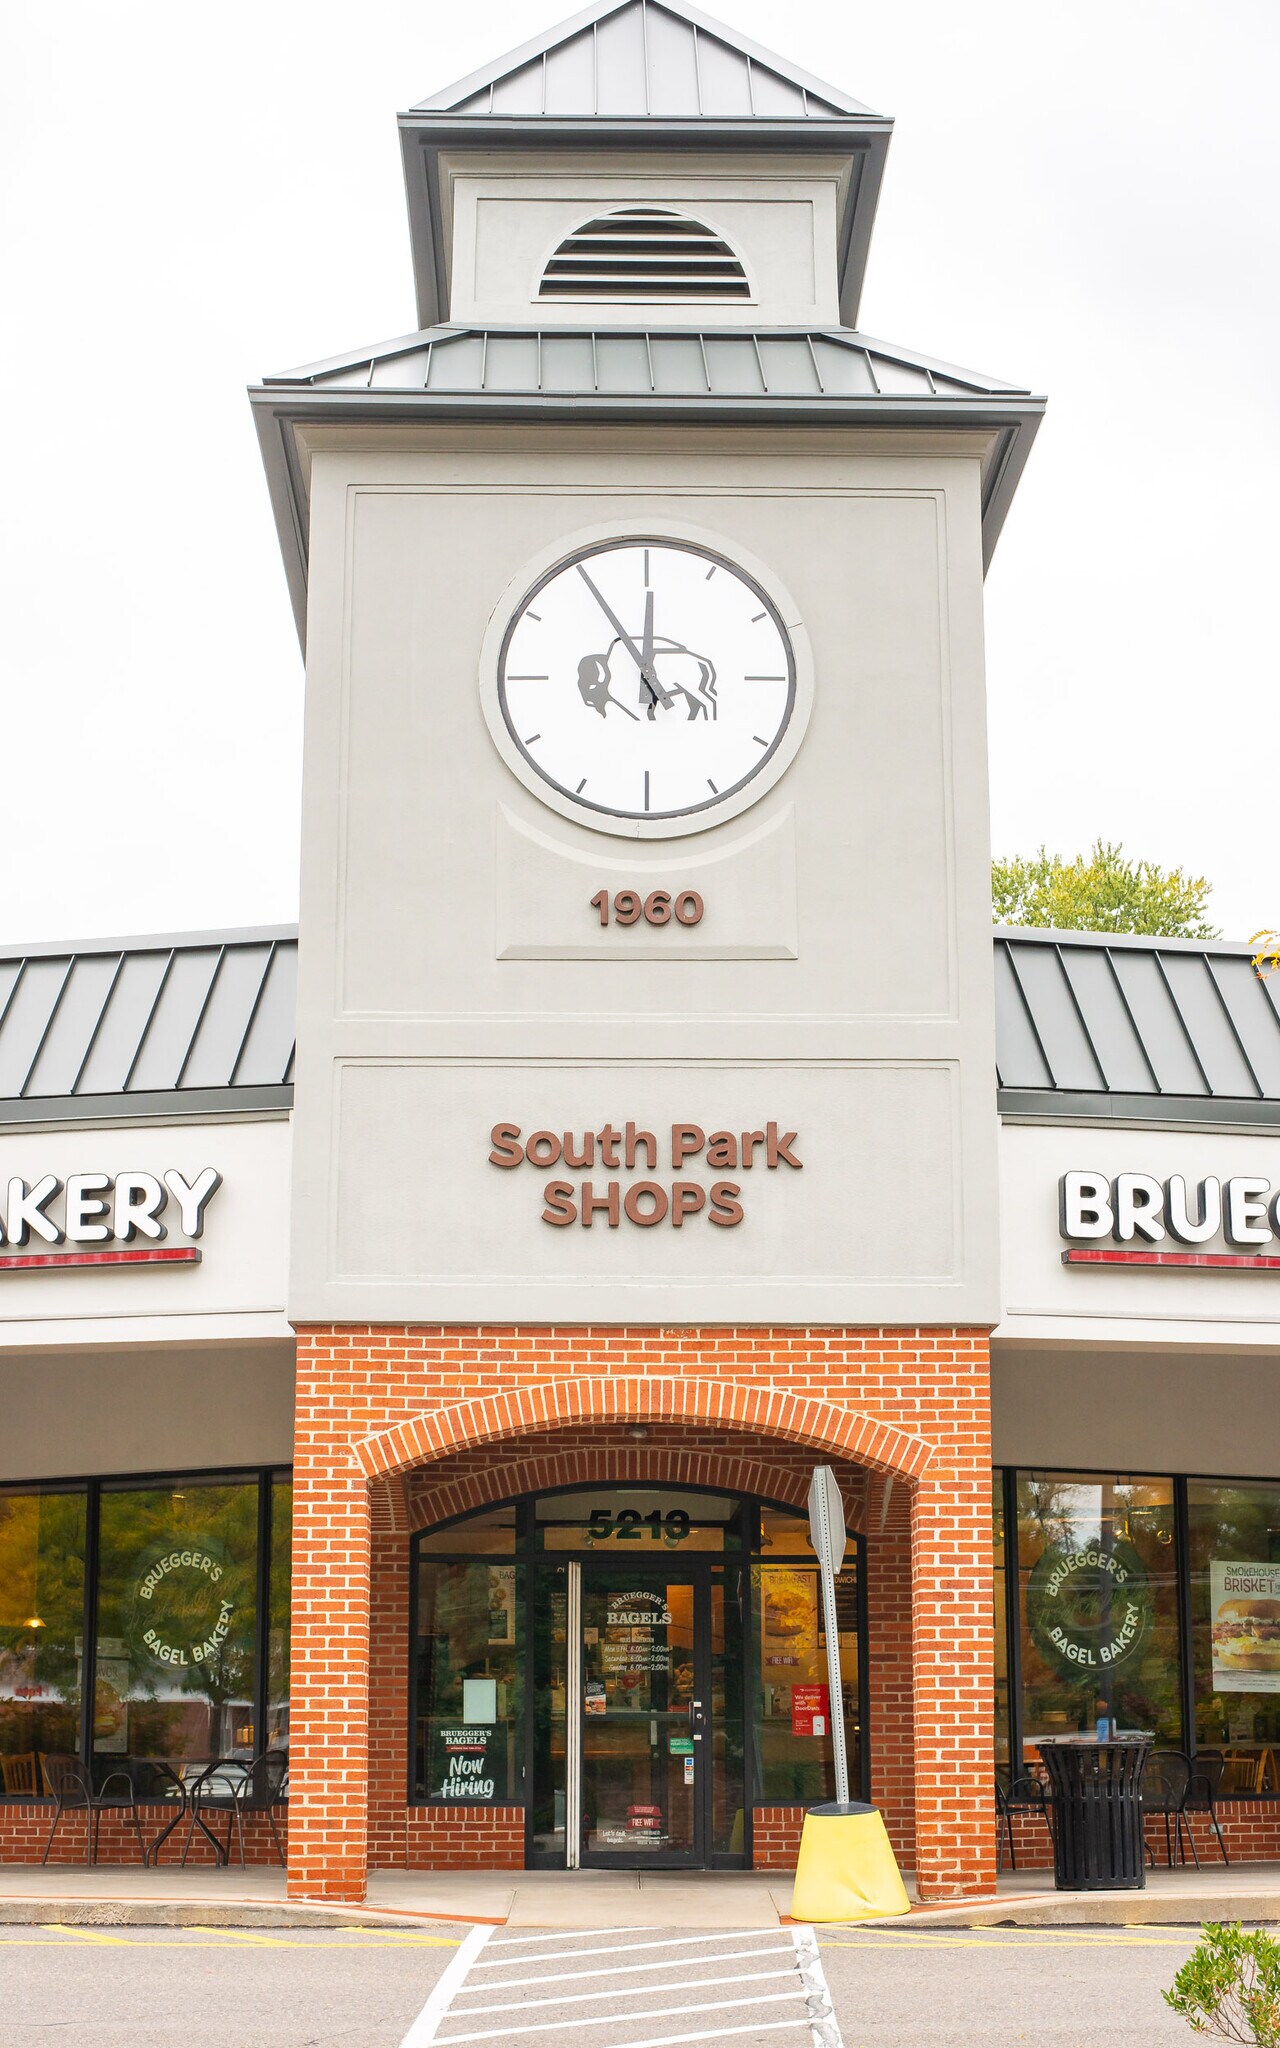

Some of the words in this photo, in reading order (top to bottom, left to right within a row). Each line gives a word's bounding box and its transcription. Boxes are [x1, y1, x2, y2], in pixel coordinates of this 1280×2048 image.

[590, 889, 705, 926] 1960
[488, 1121, 657, 1169] South
[671, 1121, 803, 1169] Park
[0, 1166, 223, 1247] KERY
[541, 1180, 745, 1228] SHOPS
[1058, 1170, 1280, 1246] BRUE
[587, 1509, 690, 1539] 5213
[140, 1551, 222, 1600] BRUEGGER'S
[1047, 1551, 1128, 1597] BRUEGGER'S
[1224, 1576, 1275, 1593] BRISKET
[1226, 1566, 1280, 1578] SMOKEHOUSE
[610, 1591, 669, 1611] BRUEGGER'S
[143, 1629, 189, 1665] BAGEL
[192, 1600, 234, 1663] BAKERY
[606, 1612, 672, 1625] BAGELS
[1048, 1627, 1096, 1665] BAGEL
[1100, 1602, 1139, 1663] BAKERY
[445, 1736, 487, 1745] BAGELS
[449, 1755, 485, 1777] Now
[440, 1775, 495, 1799] Hiring
[632, 1818, 643, 1827] FREE
